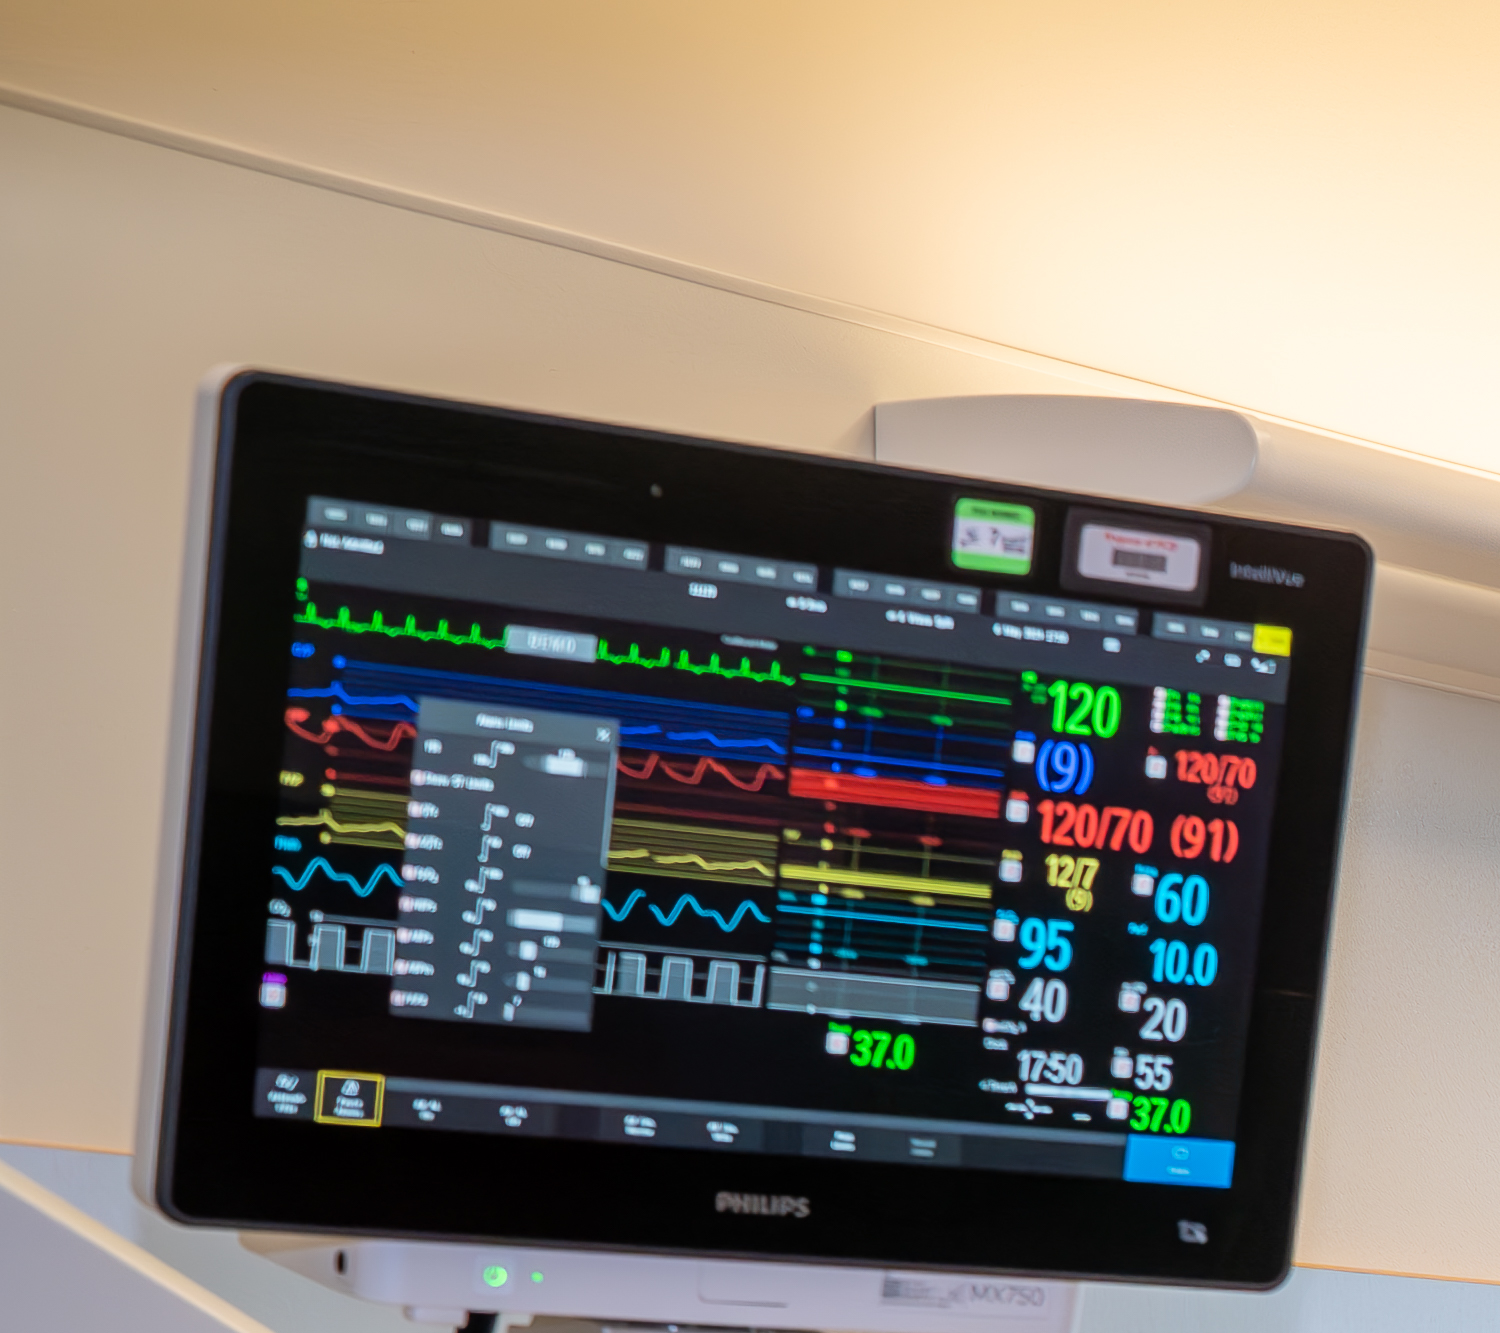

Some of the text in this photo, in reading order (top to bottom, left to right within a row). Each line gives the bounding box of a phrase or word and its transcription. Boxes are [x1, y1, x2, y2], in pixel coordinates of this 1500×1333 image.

[1049, 679, 1121, 738] 120
[1035, 739, 1094, 795] (9)
[1175, 750, 1257, 789] 120/70
[1037, 799, 1239, 863] 120/70 (91)
[1045, 853, 1100, 890] 12/7
[1154, 873, 1209, 926] 60
[1018, 917, 1075, 971] 95
[1150, 938, 1218, 986] 10.0
[1018, 977, 1068, 1023] 40
[1139, 997, 1188, 1043] 20
[850, 1029, 916, 1071] 37.0
[1134, 1054, 1173, 1091] 55
[1129, 1096, 1191, 1134] 37.0
[715, 1191, 810, 1218] PHILIPS
